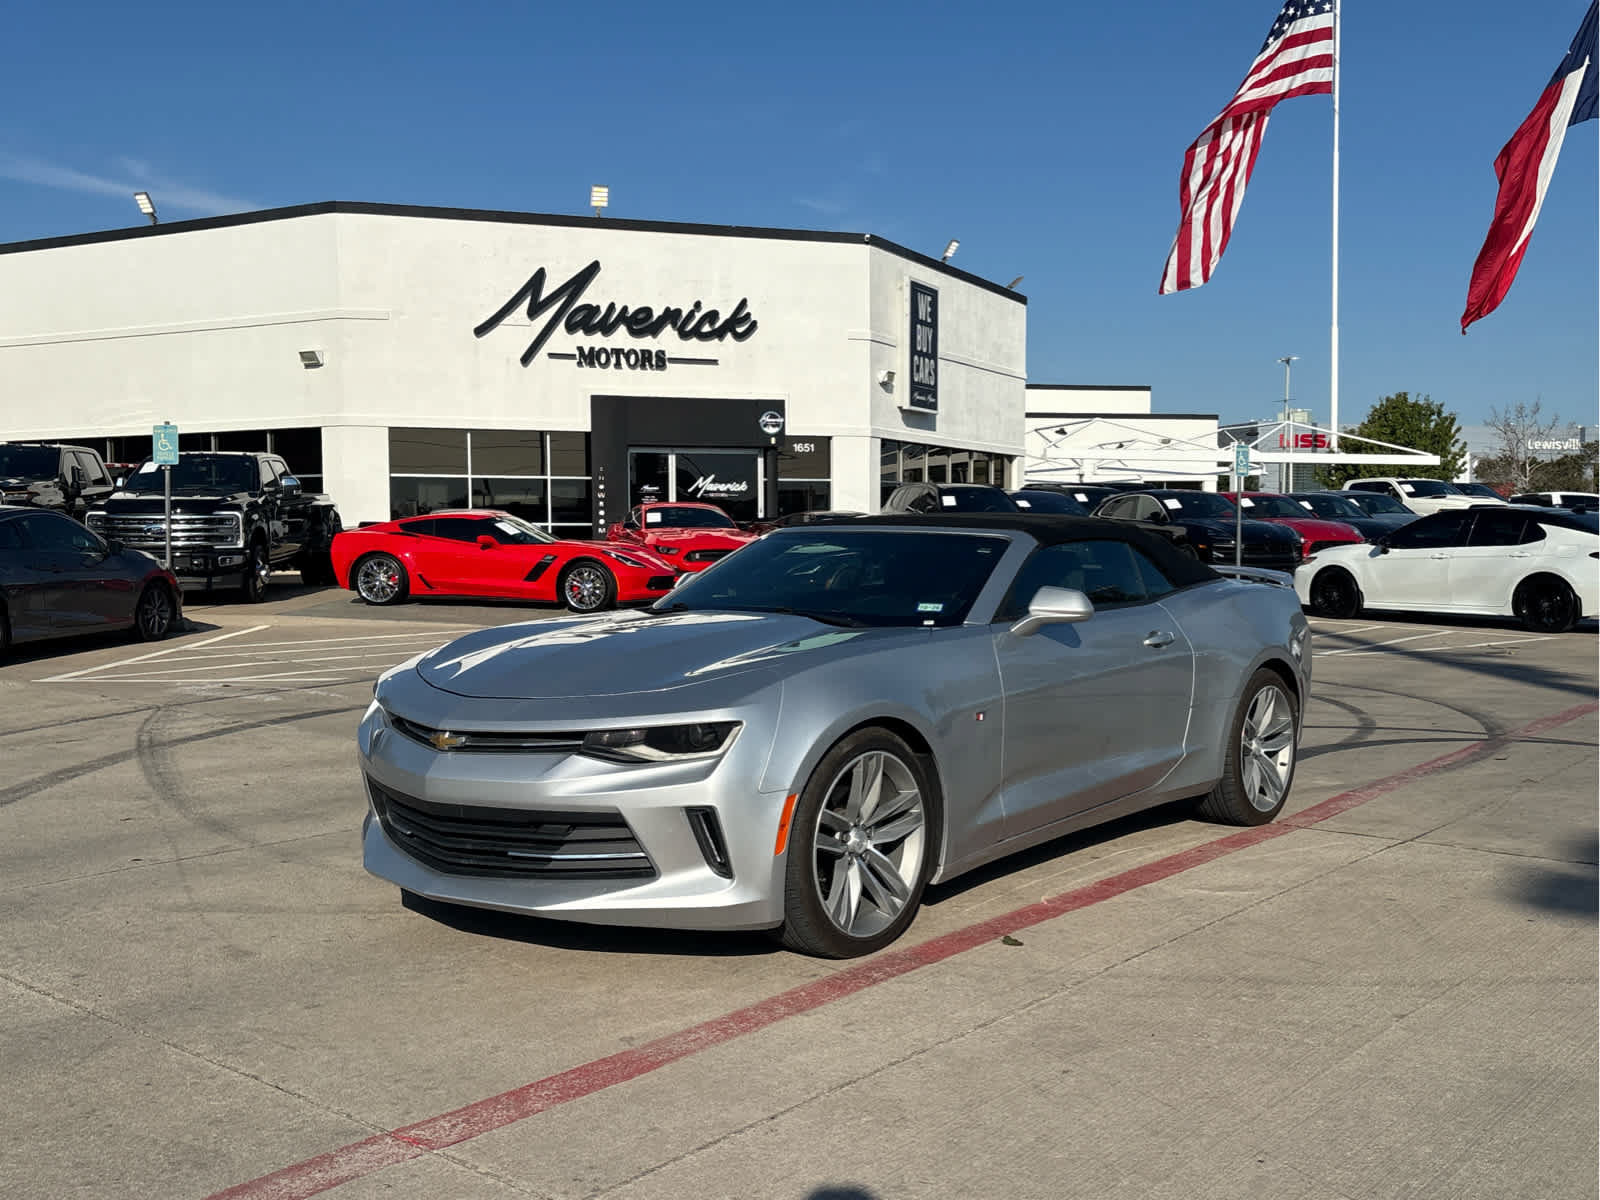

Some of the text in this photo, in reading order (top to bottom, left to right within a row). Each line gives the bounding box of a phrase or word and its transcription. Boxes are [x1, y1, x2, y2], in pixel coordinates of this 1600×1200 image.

[473, 260, 758, 368] Maverick
[917, 292, 932, 323] WE
[916, 324, 933, 354] BUY
[576, 346, 667, 371] MOTORS
[913, 355, 935, 386] CARS
[792, 443, 815, 453] 1651
[687, 473, 748, 498] Maverick
